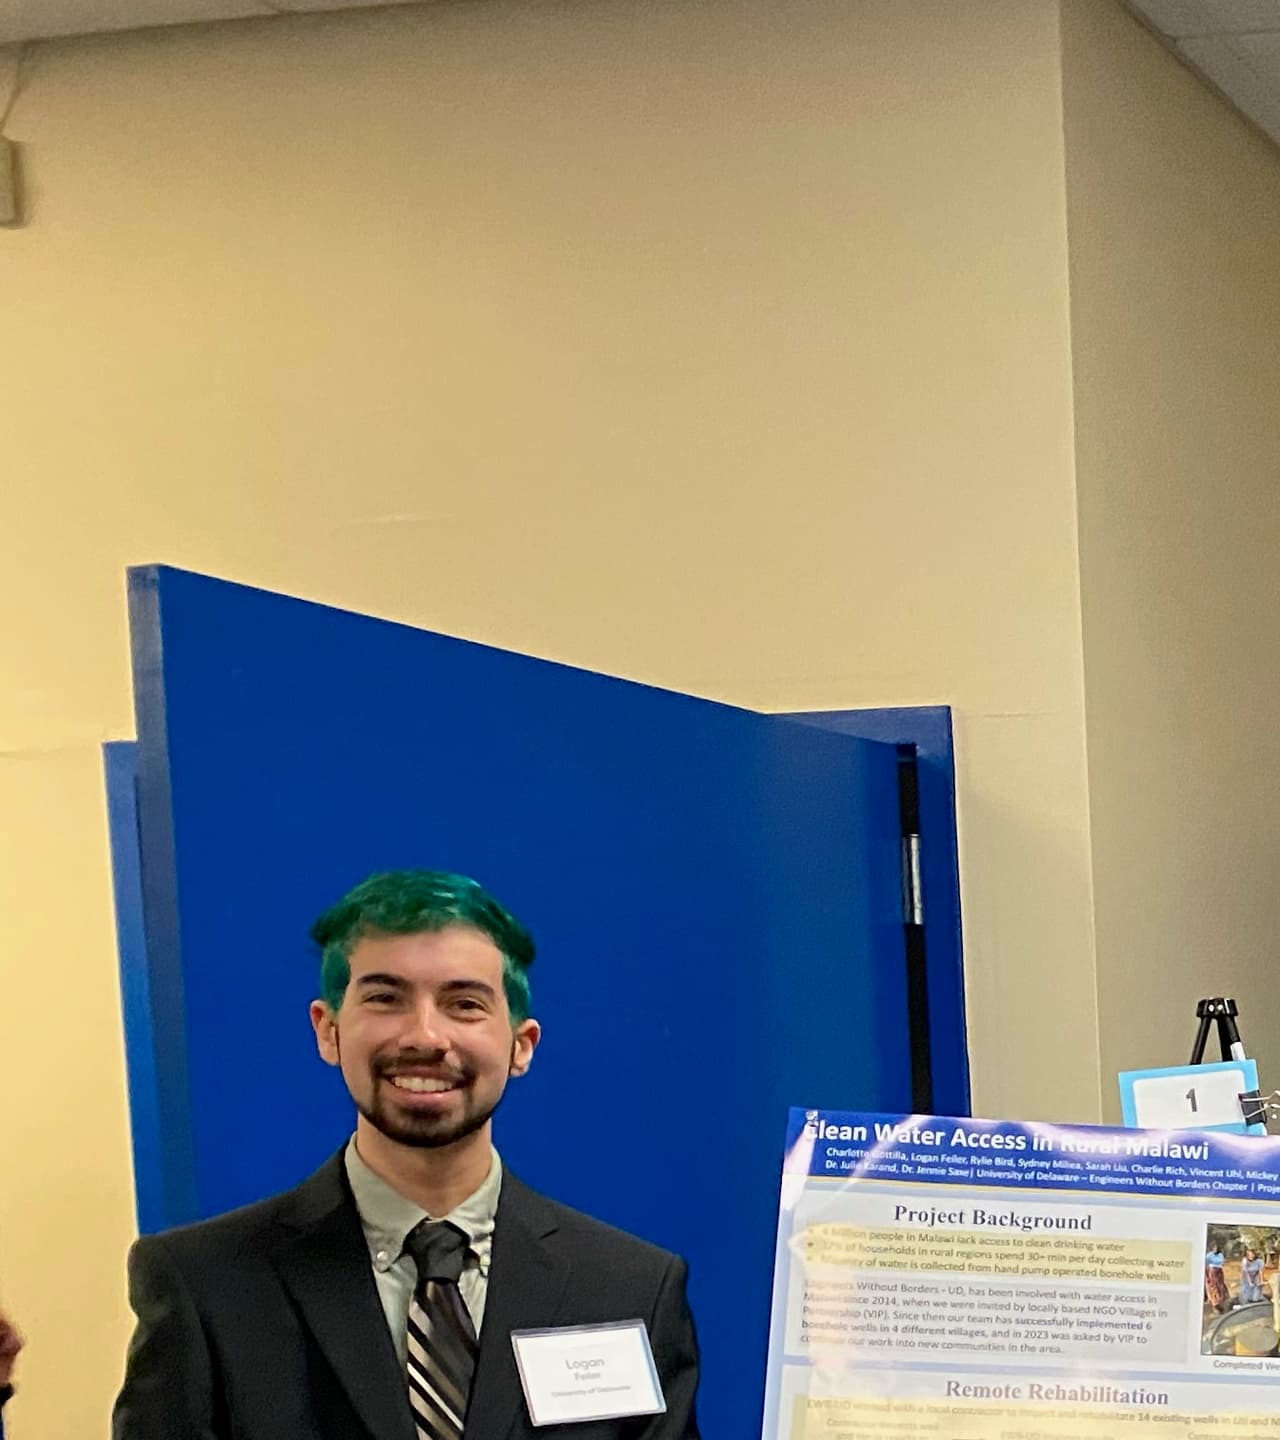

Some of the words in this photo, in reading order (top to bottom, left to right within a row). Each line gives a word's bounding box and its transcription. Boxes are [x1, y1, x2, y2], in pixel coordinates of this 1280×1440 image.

[1186, 1089, 1197, 1112] 1
[874, 1122, 943, 1146] Water
[951, 1128, 1027, 1151] Access
[1032, 1130, 1053, 1152] in
[1126, 1137, 1209, 1161] Malawi
[894, 1205, 964, 1227] Project
[973, 1209, 1091, 1232] Background
[944, 1380, 1021, 1399] Remote
[1029, 1383, 1168, 1406] Rehabilitation
